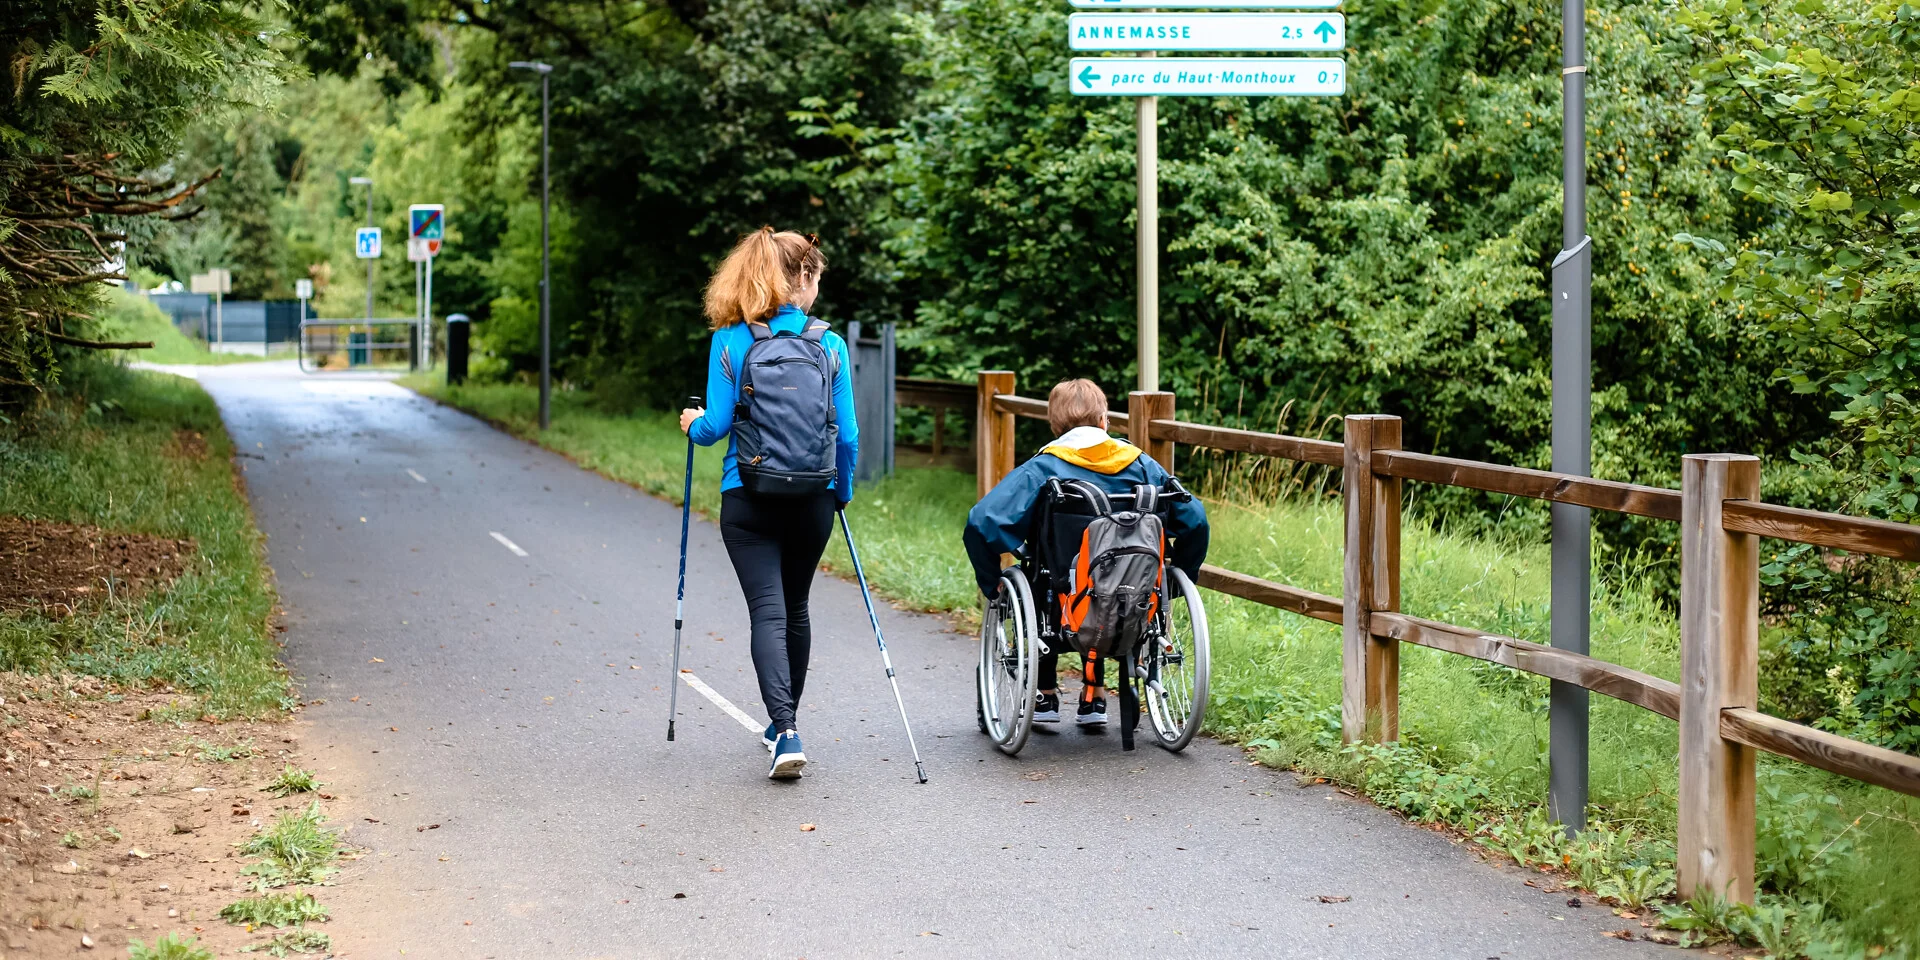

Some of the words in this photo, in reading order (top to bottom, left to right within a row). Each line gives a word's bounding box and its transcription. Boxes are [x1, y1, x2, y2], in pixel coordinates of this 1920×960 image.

[1077, 25, 1191, 39] ANNEMASSE
[1281, 25, 1304, 40] 2,5
[1111, 73, 1145, 87] parc
[1152, 71, 1171, 84] du
[1176, 70, 1296, 85] Haut-Monthoux
[1317, 70, 1340, 85] 0,7
